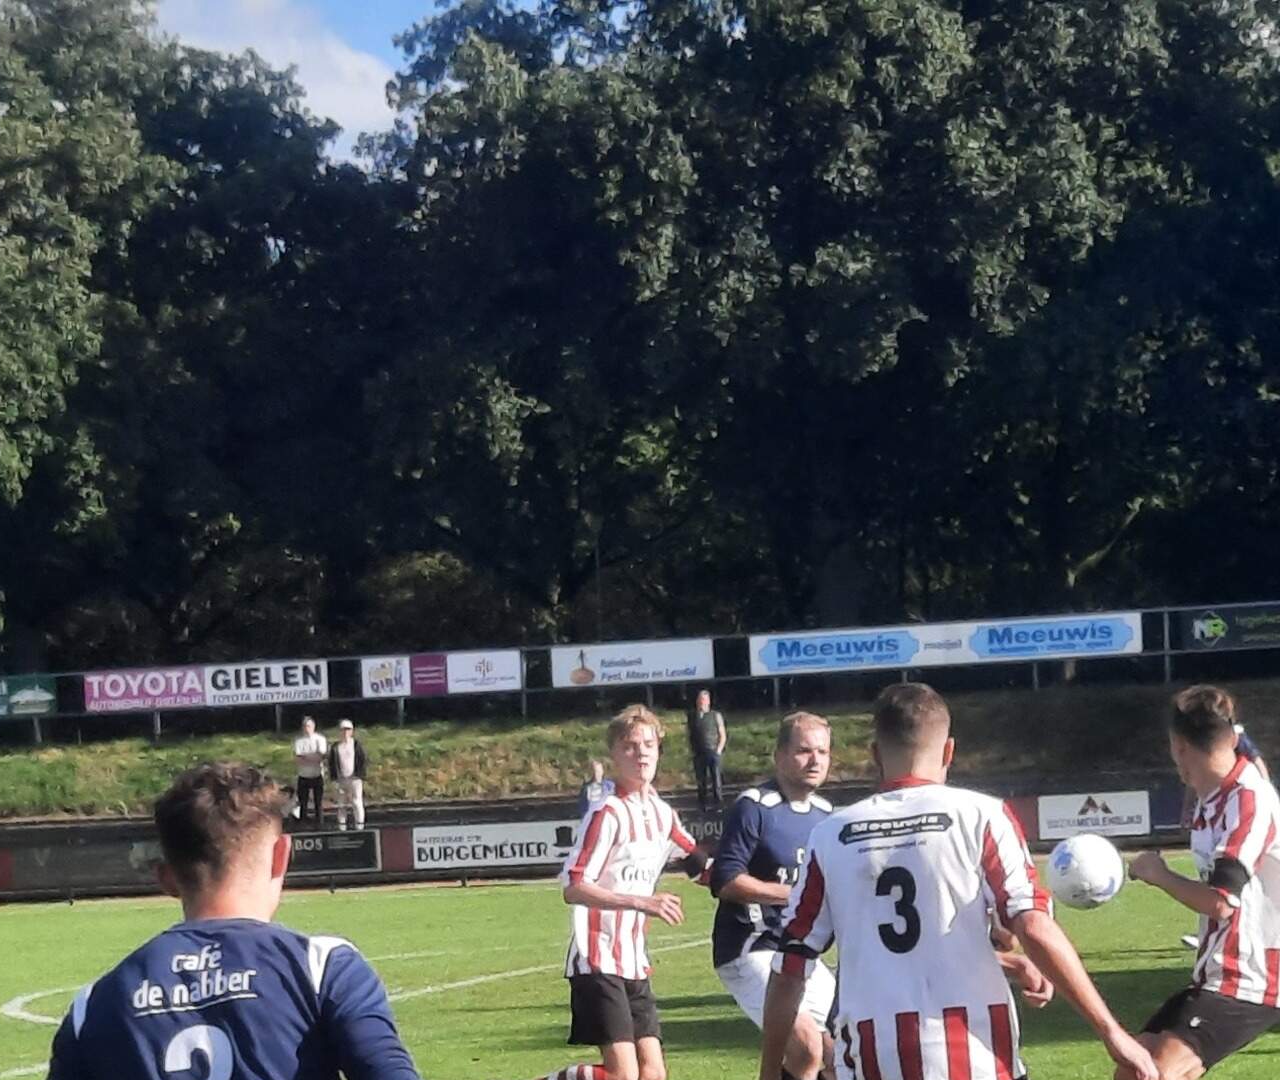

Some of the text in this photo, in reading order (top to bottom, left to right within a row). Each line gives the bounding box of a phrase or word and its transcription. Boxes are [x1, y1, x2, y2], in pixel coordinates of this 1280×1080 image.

[776, 635, 899, 658] Meeuwis
[988, 624, 1113, 646] Meeuwis
[85, 664, 322, 699] TOYOTA GIELEN
[875, 866, 921, 954] 3
[171, 944, 223, 974] café
[132, 969, 257, 1009] de nabber
